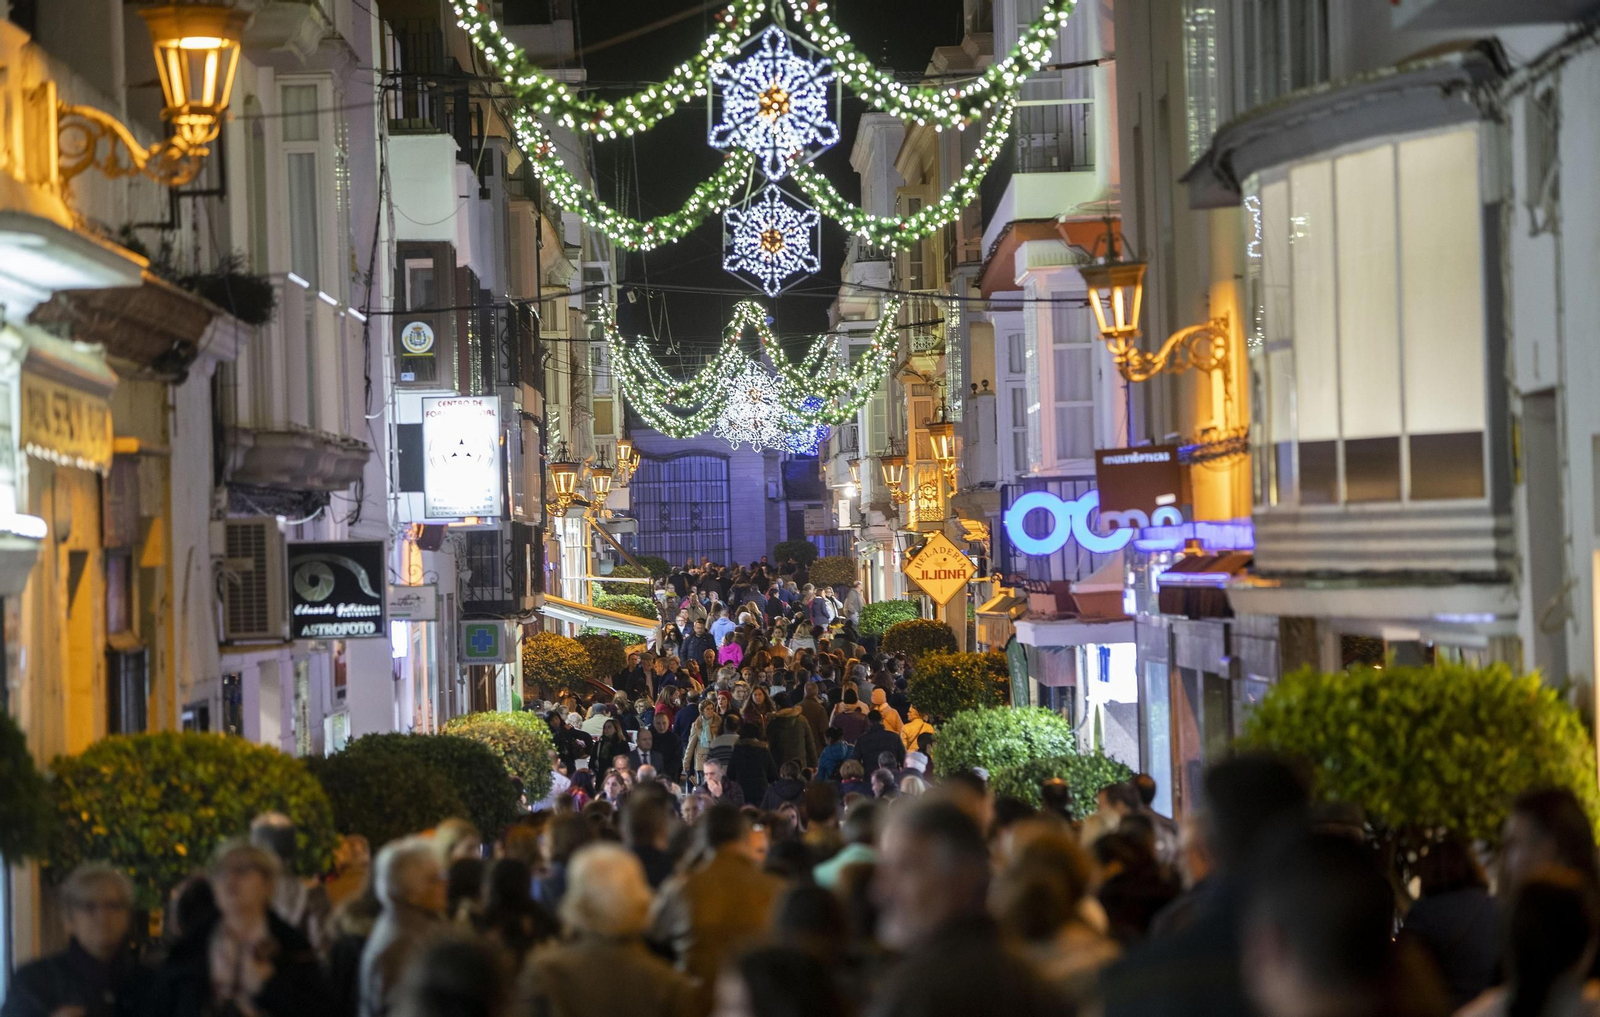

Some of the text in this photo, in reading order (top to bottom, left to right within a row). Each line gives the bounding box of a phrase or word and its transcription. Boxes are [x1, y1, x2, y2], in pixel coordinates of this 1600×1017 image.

[437, 399, 483, 408] CENTRO DE
[915, 546, 967, 570] HELADERIA
[916, 569, 967, 580] JIJONA
[301, 621, 376, 637] ASTROFOTO
